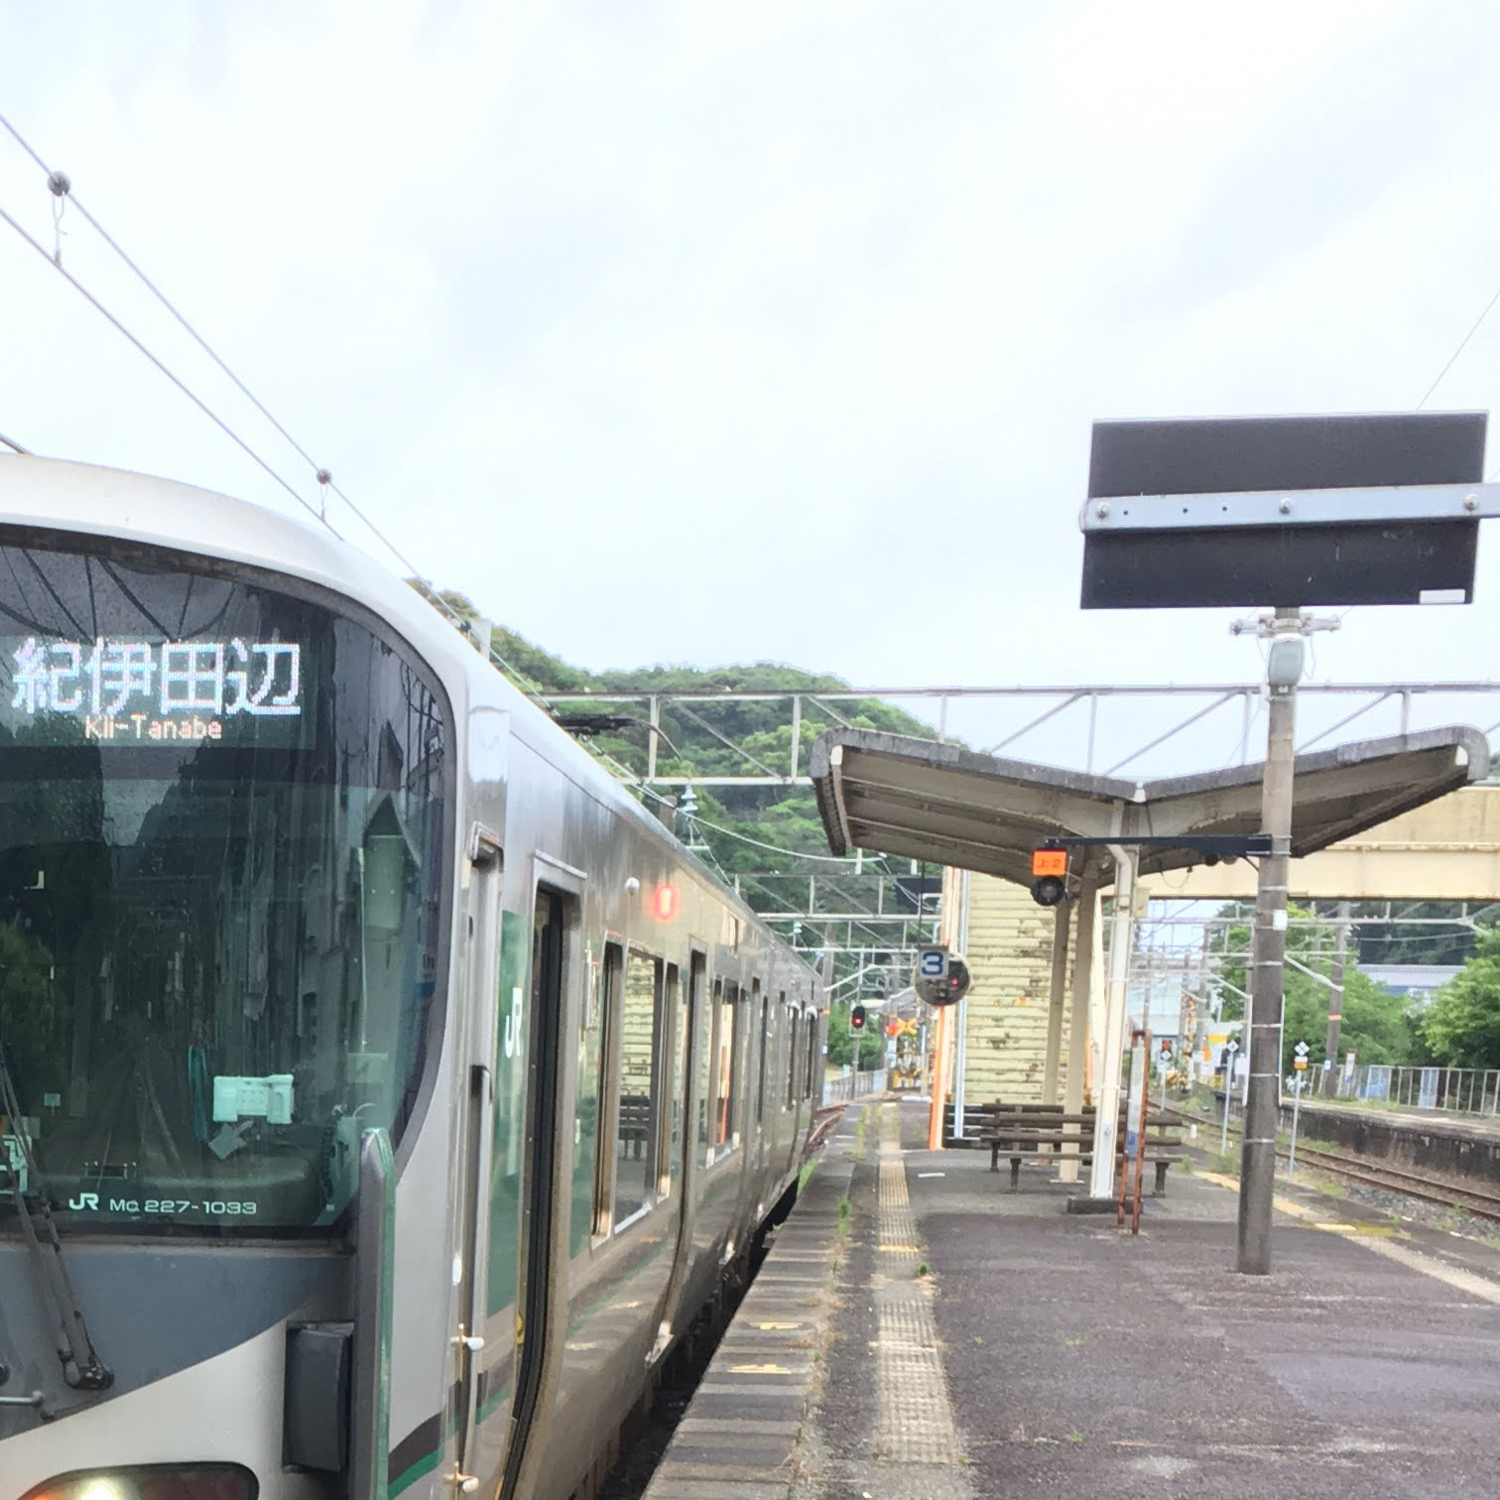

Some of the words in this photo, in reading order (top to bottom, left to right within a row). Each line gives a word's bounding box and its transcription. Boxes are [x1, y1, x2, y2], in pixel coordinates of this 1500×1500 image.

[11, 635, 301, 716] 紀伊田辺
[85, 712, 222, 740] Kii-Tanabe
[921, 951, 944, 975] 3
[504, 987, 522, 1059] JR
[68, 1193, 99, 1211] JR
[143, 1199, 257, 1215] 227-1033
